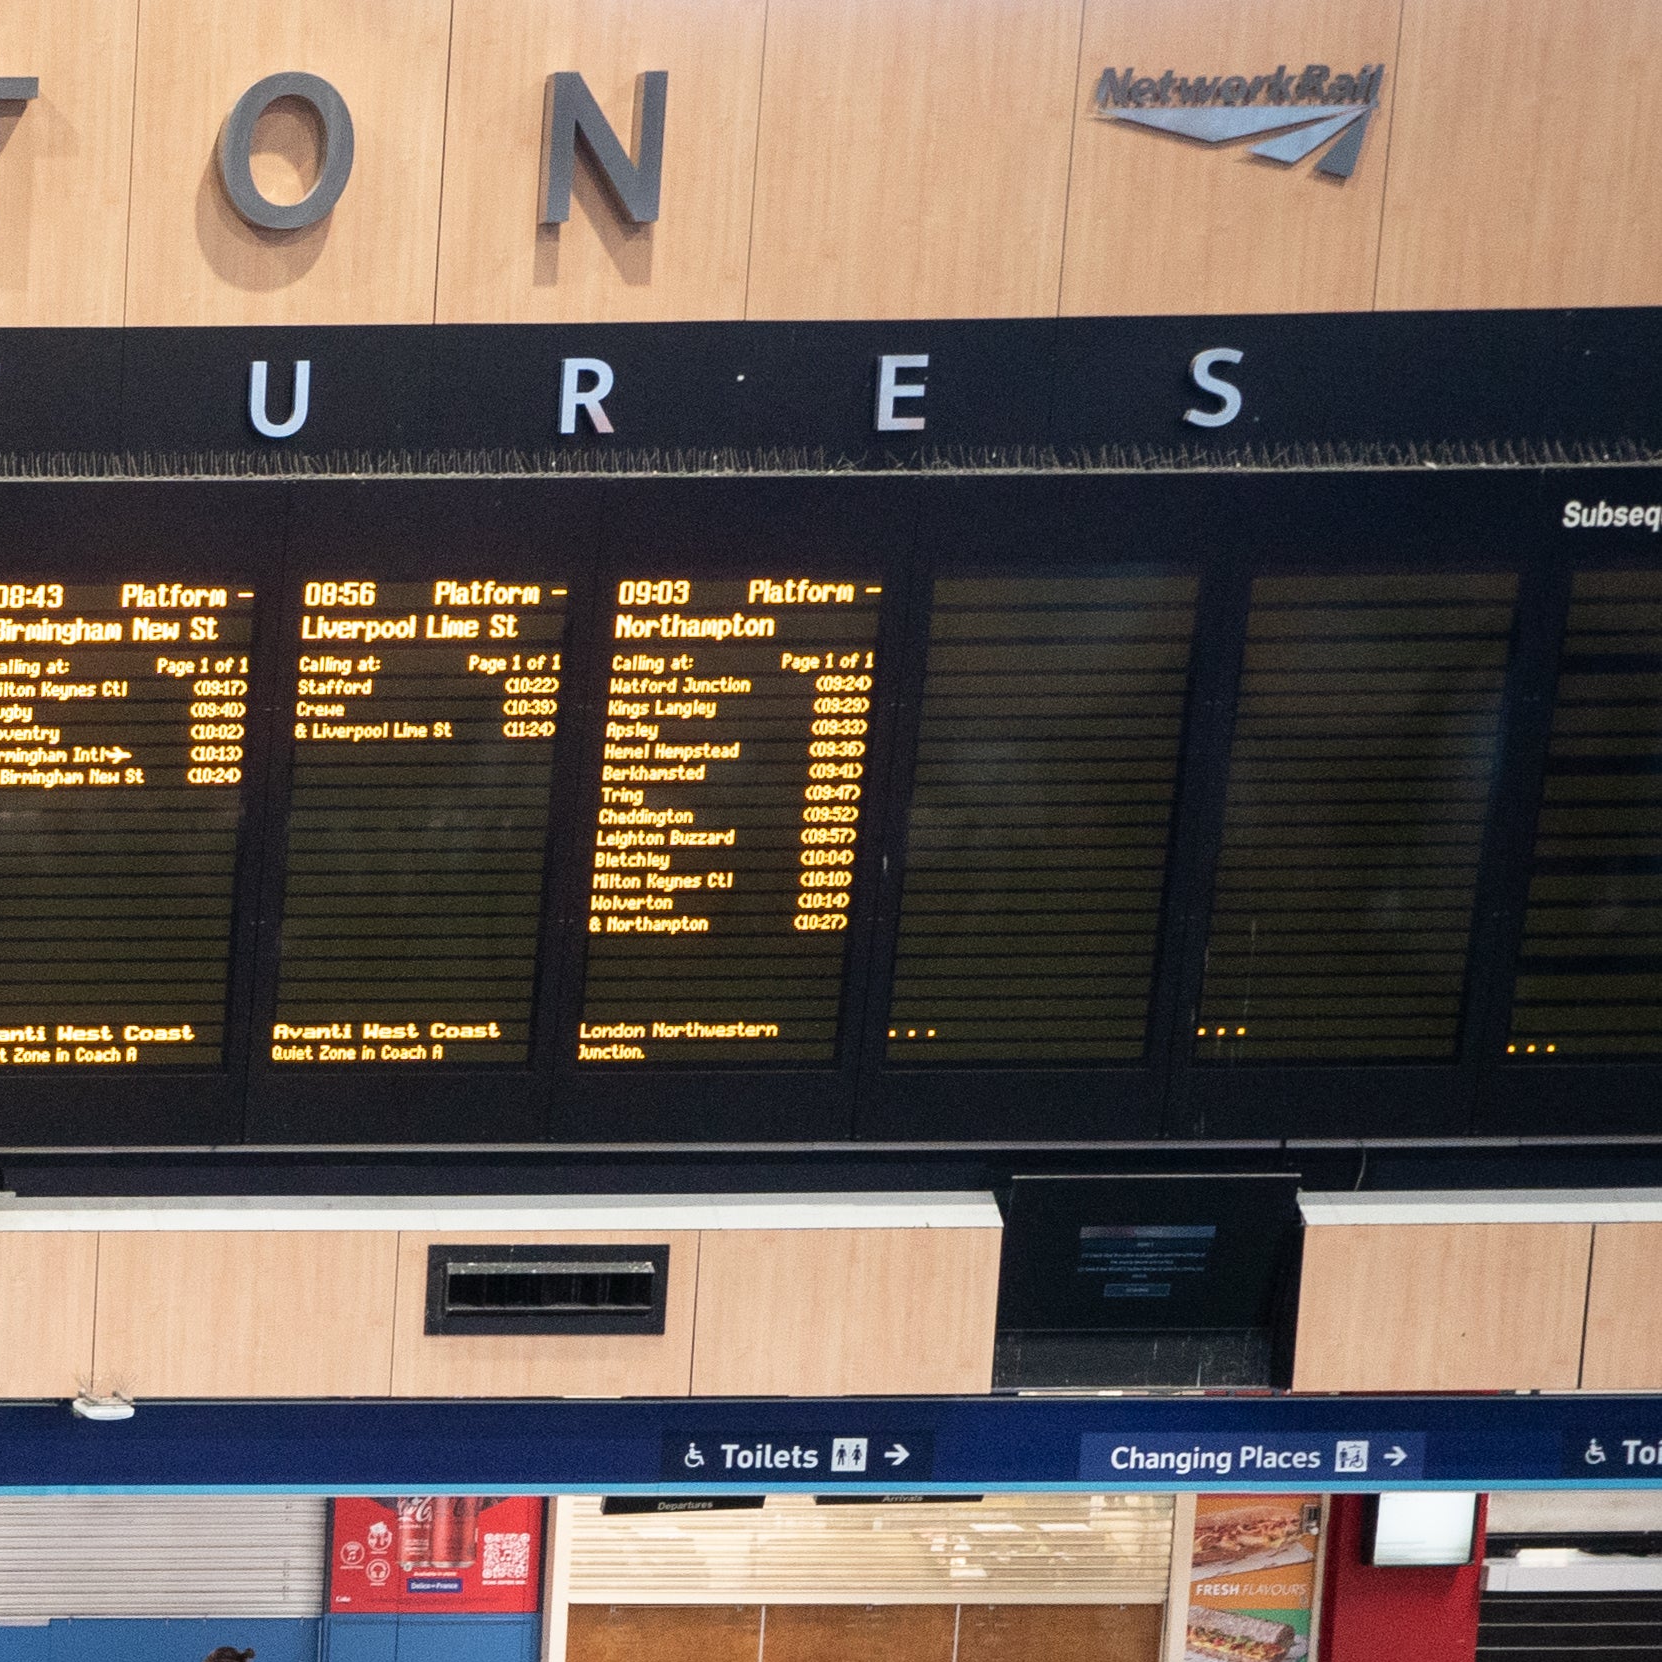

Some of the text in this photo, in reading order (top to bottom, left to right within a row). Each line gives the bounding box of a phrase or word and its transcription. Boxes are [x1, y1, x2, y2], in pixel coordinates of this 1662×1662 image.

[1562, 500, 1662, 533] Subseq
[120, 583, 228, 608] Platform
[304, 580, 541, 607] 08:56 Platform
[618, 578, 855, 606] 09:03 Platform
[131, 616, 181, 642] New
[189, 616, 219, 641] St
[301, 613, 519, 643] Liverpool Lime St
[614, 612, 776, 641] Northampton
[579, 1021, 779, 1039] London Northwestern
[720, 1443, 819, 1469] Toilets
[1110, 1445, 1321, 1475] Changing Places
[657, 1501, 713, 1511] Departures
[882, 1495, 923, 1503] Arrivals
[1195, 1583, 1308, 1596] FRESH FLAVOURS
